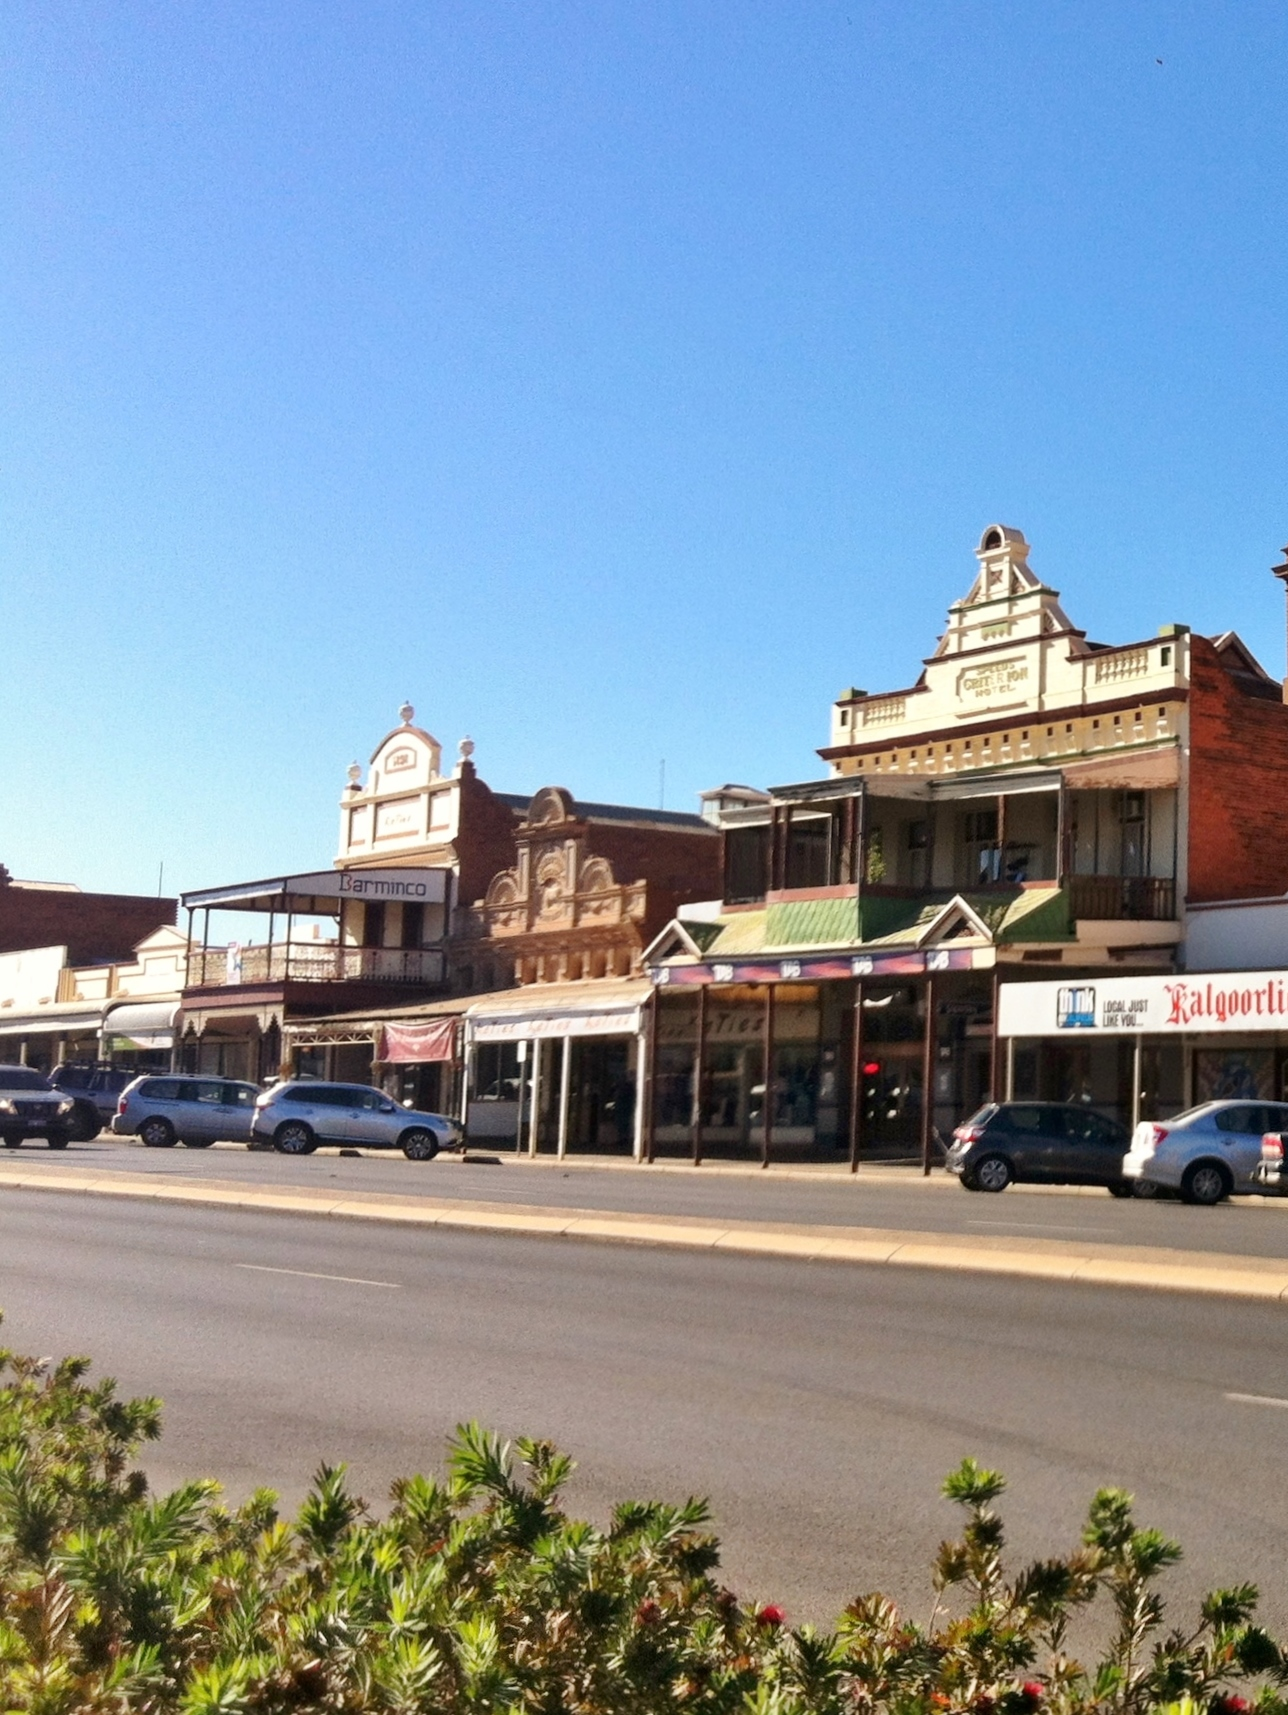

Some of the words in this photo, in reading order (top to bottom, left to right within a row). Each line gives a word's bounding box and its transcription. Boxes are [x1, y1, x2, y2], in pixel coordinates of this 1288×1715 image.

[963, 667, 1028, 691] CRITERION
[975, 684, 1016, 698] HOTEL
[339, 873, 427, 897] Barminco
[1103, 1000, 1126, 1013] LOCAL
[1128, 999, 1149, 1013] JUST
[1103, 1014, 1119, 1027] LIKE
